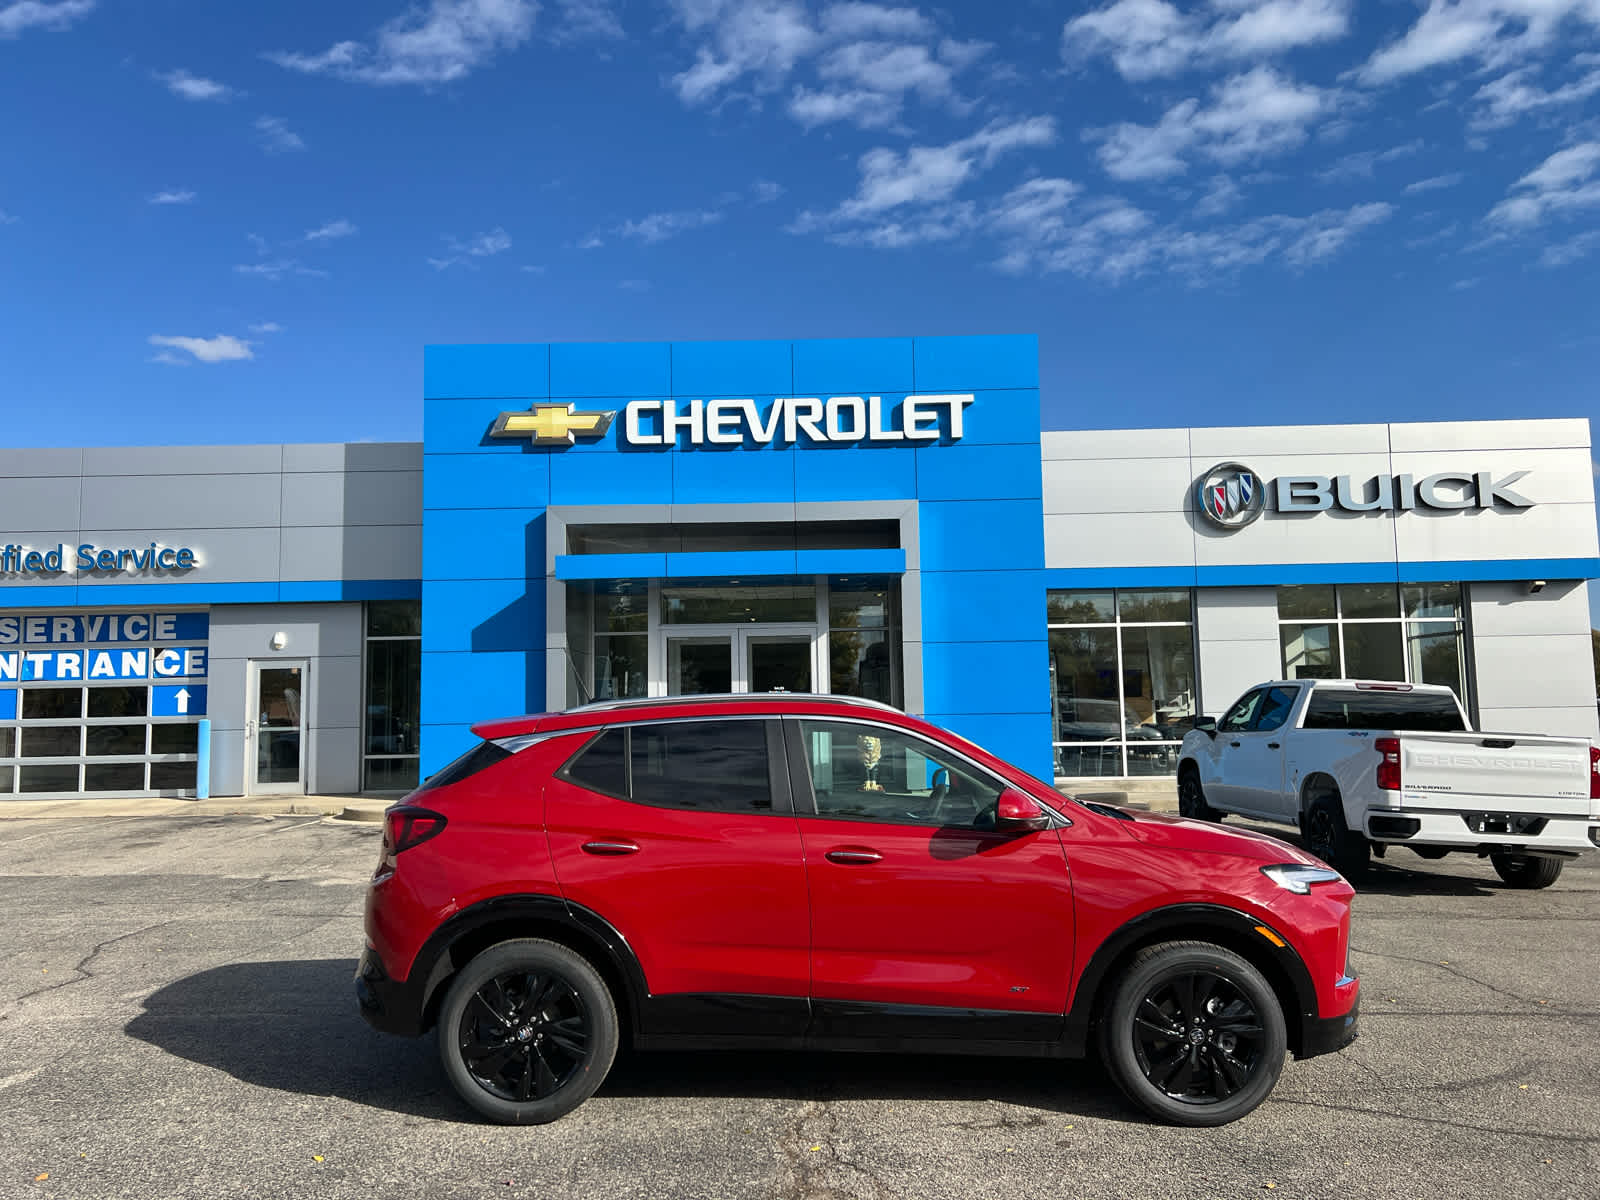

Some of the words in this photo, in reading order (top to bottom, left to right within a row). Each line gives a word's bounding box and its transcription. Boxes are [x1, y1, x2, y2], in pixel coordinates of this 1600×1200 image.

[626, 394, 975, 444] CHEVROLET
[1275, 470, 1537, 512] BUICK
[76, 543, 195, 571] Service
[0, 615, 177, 643] SERVICE
[0, 650, 206, 680] NTRANCE
[1415, 754, 1583, 772] CHEVROLET
